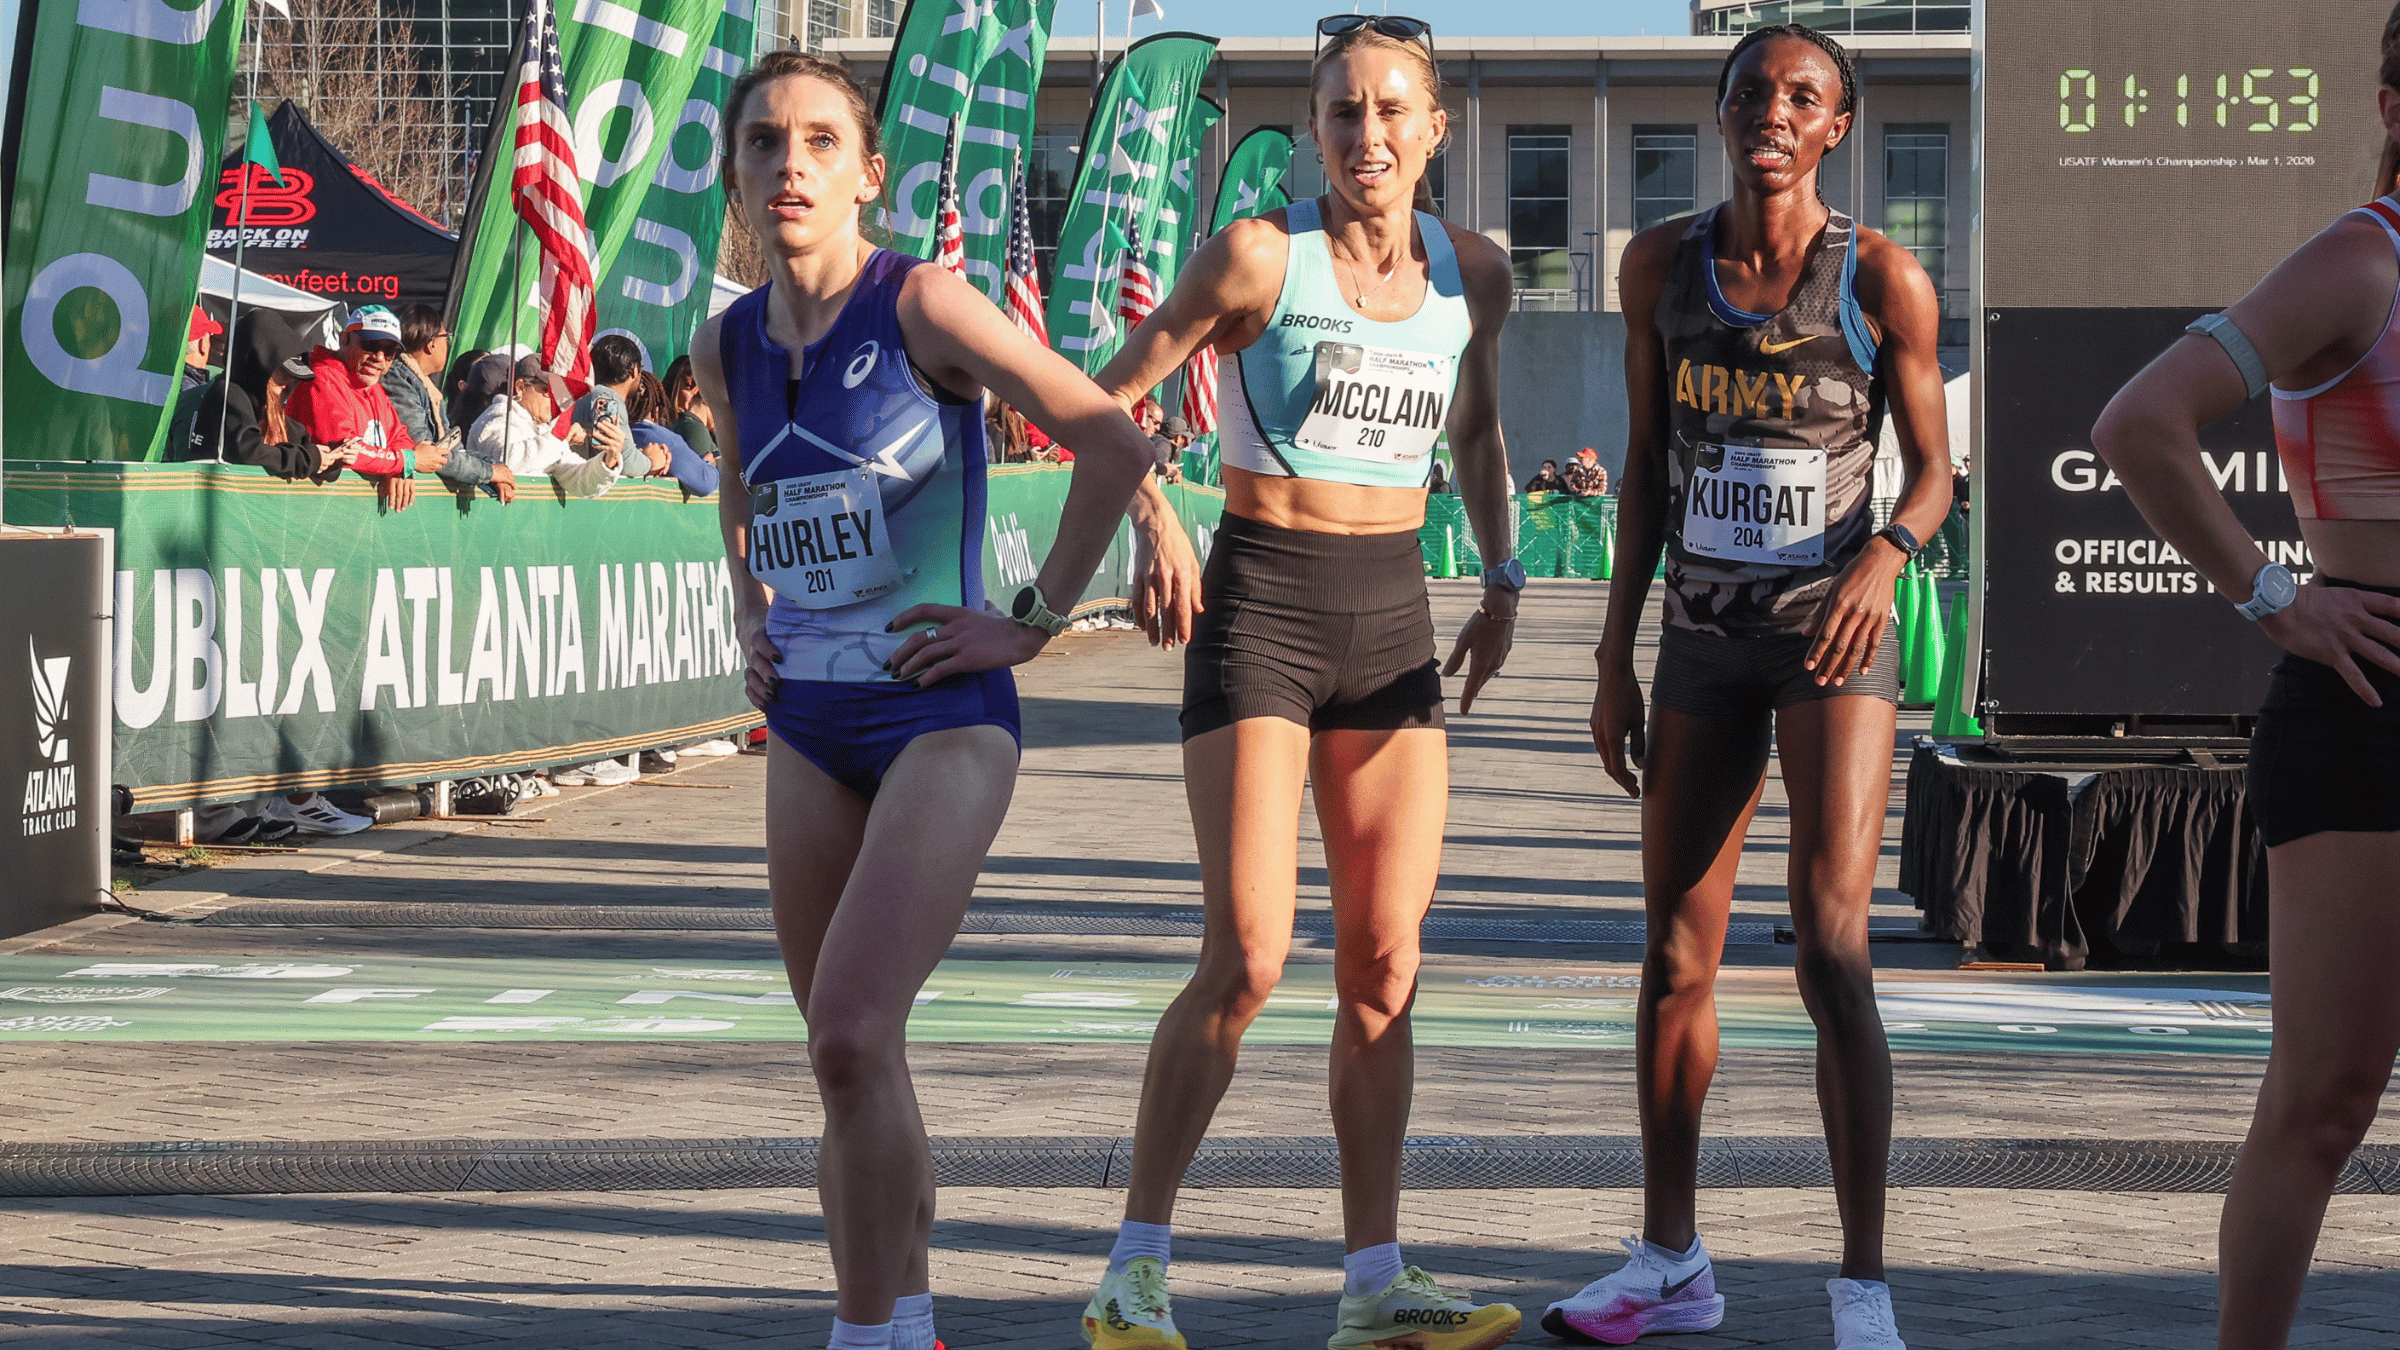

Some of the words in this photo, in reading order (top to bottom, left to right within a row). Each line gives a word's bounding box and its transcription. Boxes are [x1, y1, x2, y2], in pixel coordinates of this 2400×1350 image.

[2059, 157, 2098, 167] USATF
[2101, 157, 2153, 167] Women's
[2156, 157, 2237, 169] Championship
[2247, 157, 2269, 166] Mar
[207, 228, 268, 240] BACK
[275, 228, 309, 240] ON
[1280, 313, 1353, 334] BROOKS
[1389, 358, 1428, 368] MARATHON
[1676, 358, 1806, 420] ARMY
[1313, 379, 1444, 430] MCCLAIN
[1357, 427, 1386, 448] 210
[1731, 461, 1776, 470] CHAMPIONSHIPS
[1751, 457, 1797, 466] MARATHON
[2051, 450, 2289, 492] GMI
[784, 488, 803, 498] HALF
[803, 481, 846, 495] MARATHON
[785, 492, 829, 503] CHAMPIONSHIPS
[1692, 475, 1815, 527] KURGAT
[753, 509, 874, 572] HURLEY
[1733, 526, 1764, 549] 204
[2055, 539, 2191, 565] OFFICIA
[805, 568, 835, 594] 201
[2054, 571, 2077, 593] &
[2086, 572, 2198, 593] RESULTS
[114, 567, 336, 729] UBLIX
[359, 565, 586, 710] ATLANTA
[597, 556, 746, 692] MARATHO
[23, 764, 76, 815] ATLANTA
[23, 814, 52, 836] TRACK
[55, 809, 76, 831] CLUB
[1393, 1308, 1472, 1326] BROOKS
